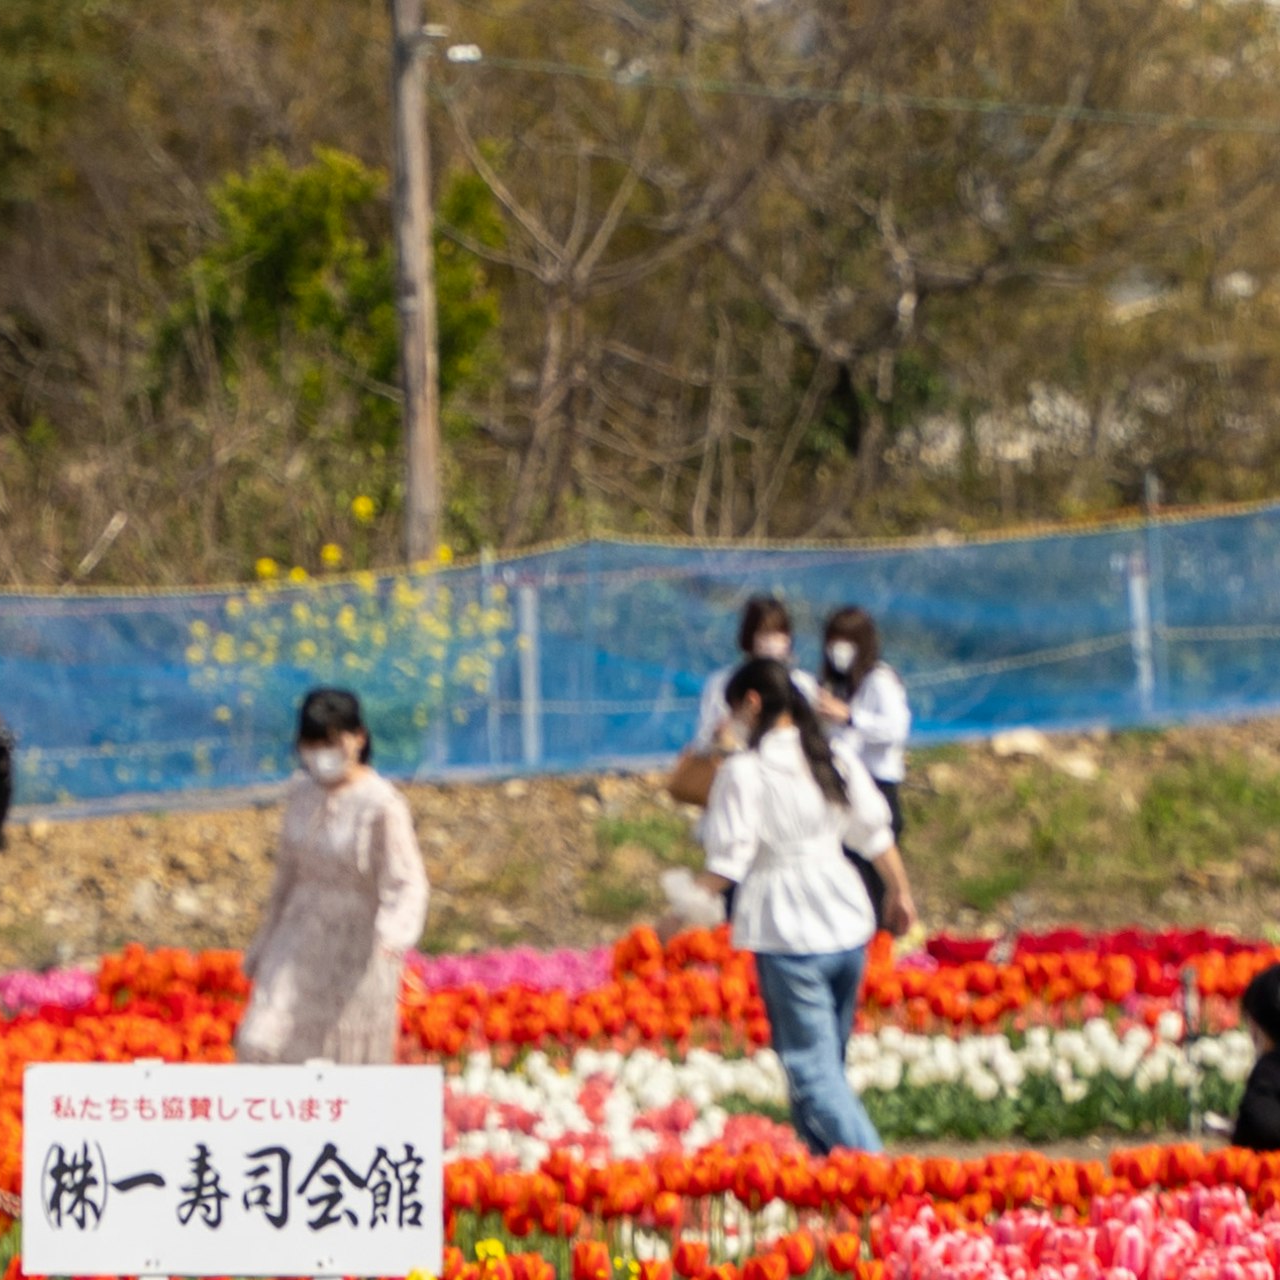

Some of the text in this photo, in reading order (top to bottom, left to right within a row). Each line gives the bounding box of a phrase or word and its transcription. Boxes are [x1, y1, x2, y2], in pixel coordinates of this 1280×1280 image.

[51, 1095, 350, 1122] 私たちも協賛しています
